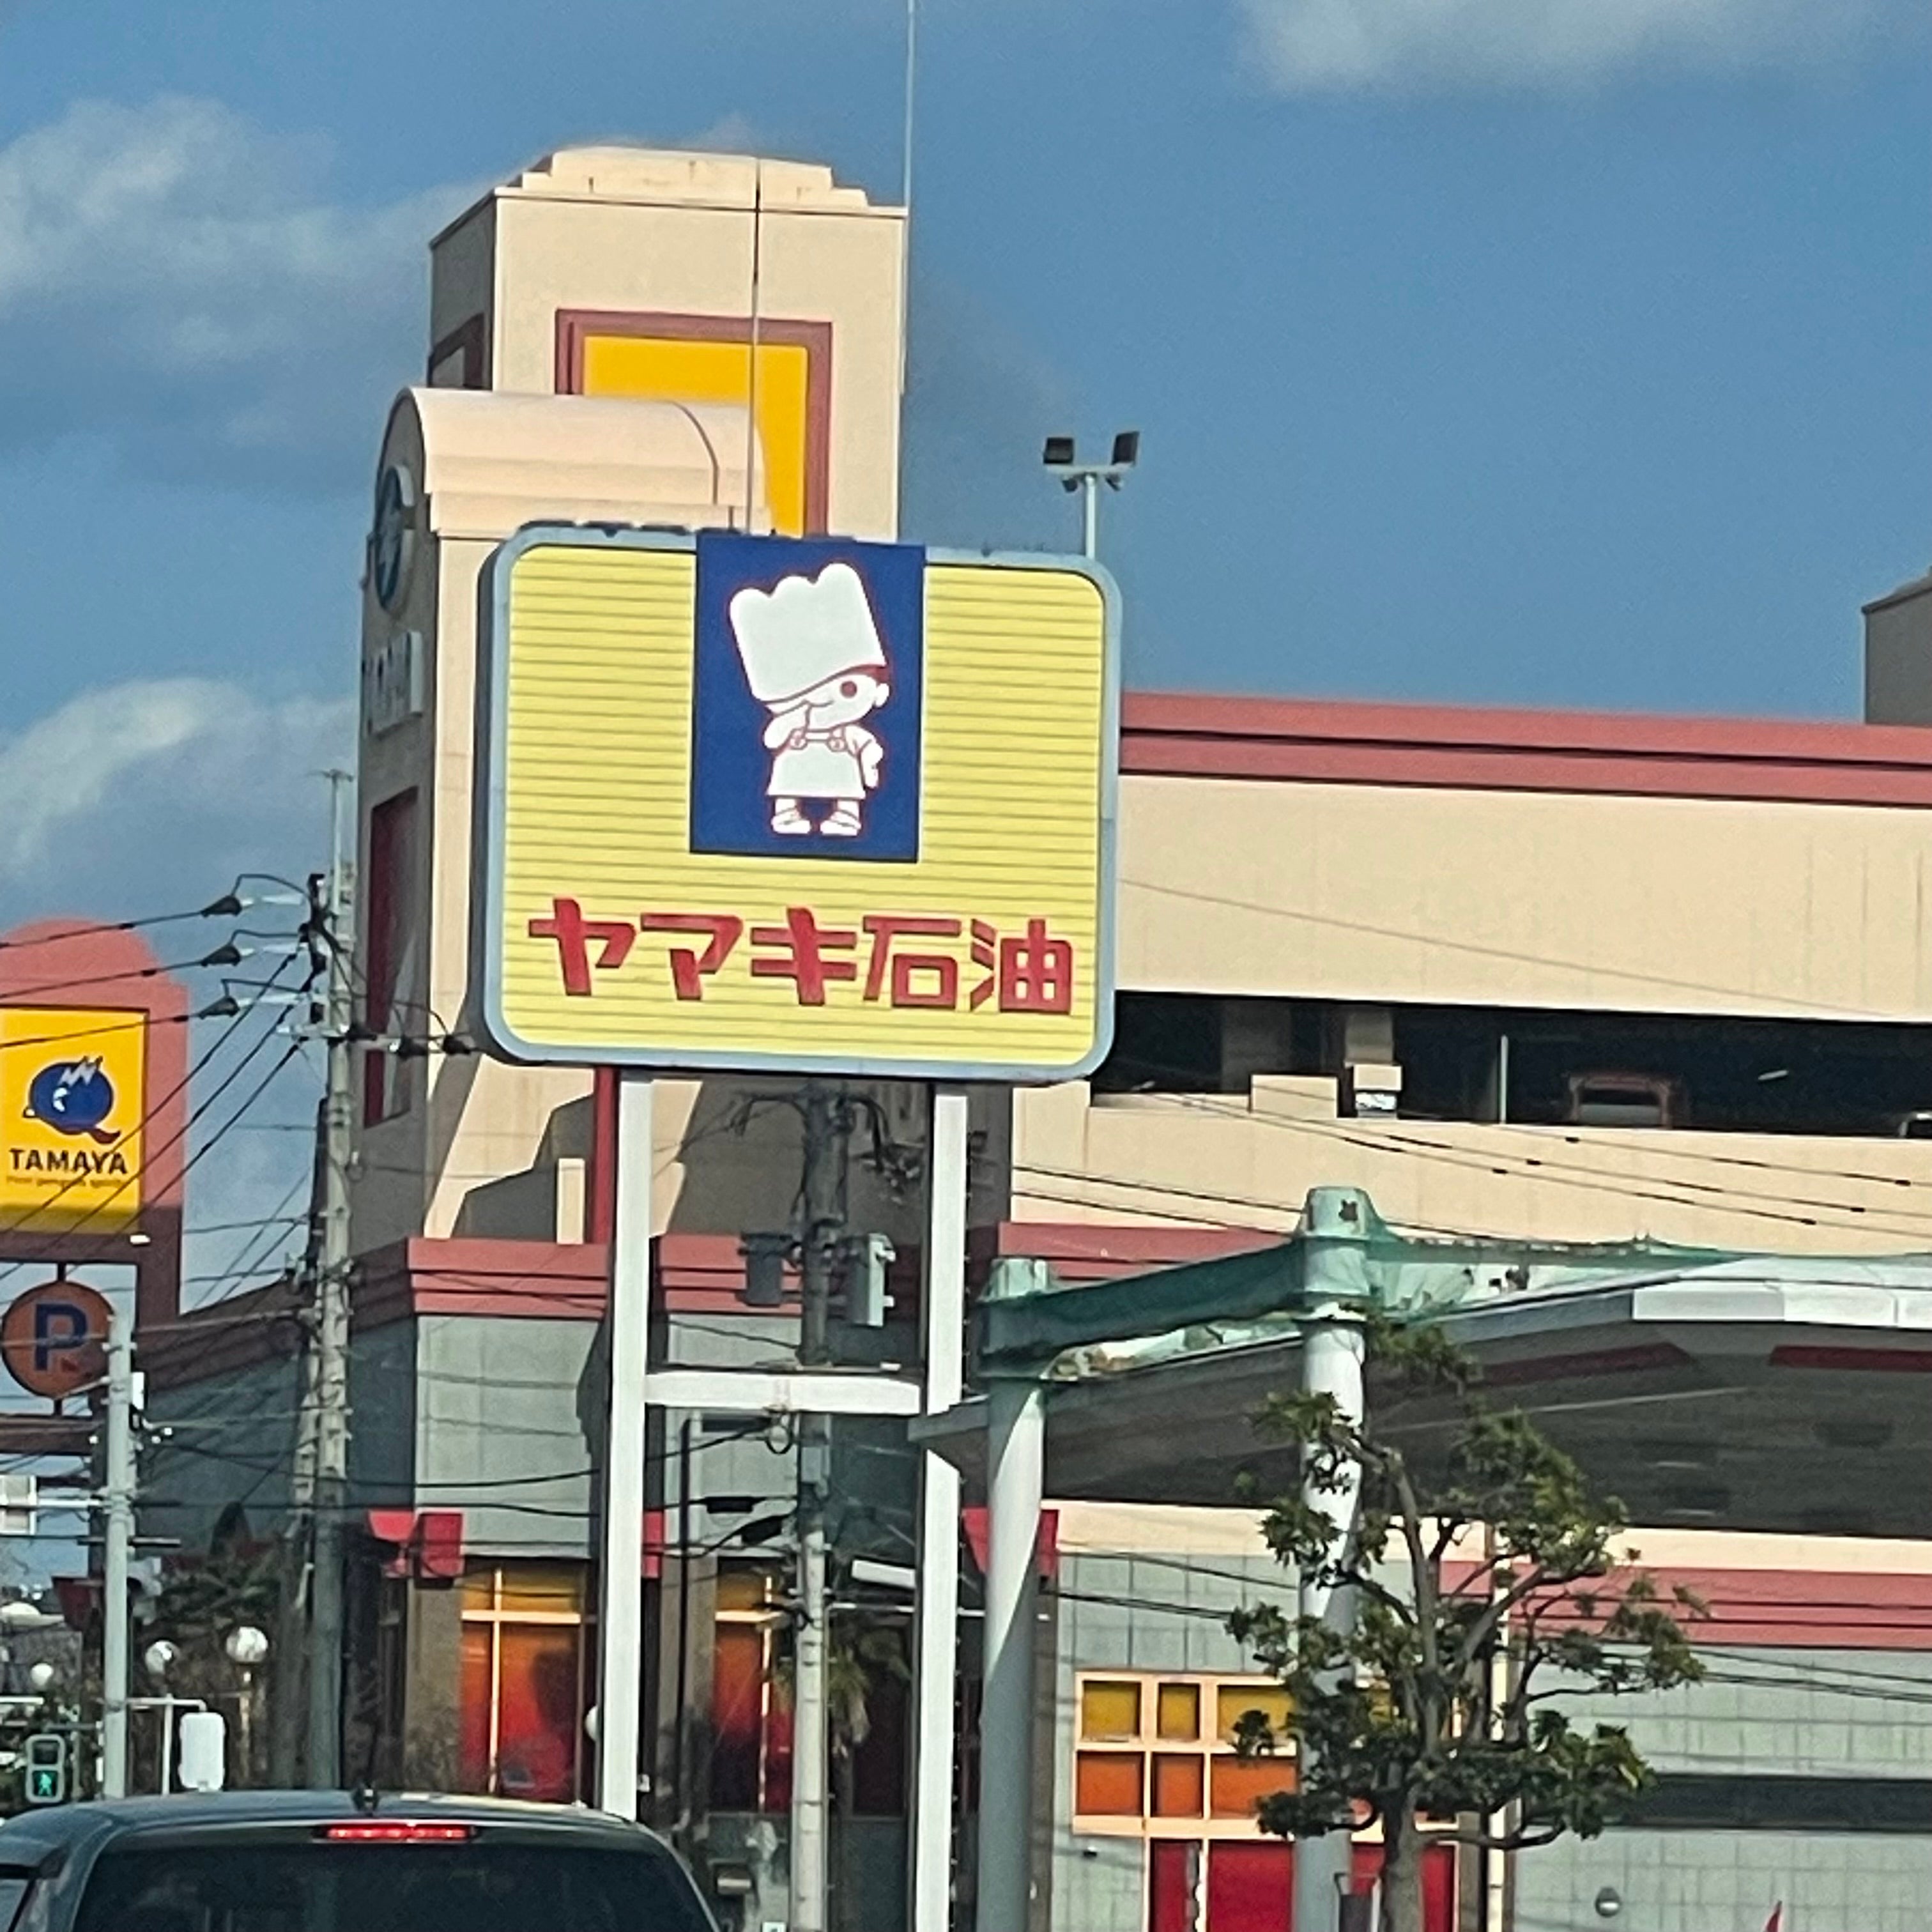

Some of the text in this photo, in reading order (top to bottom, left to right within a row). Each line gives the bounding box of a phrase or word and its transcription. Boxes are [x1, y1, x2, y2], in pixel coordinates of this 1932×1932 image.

[528, 898, 1073, 1014] ヤマキ石油
[9, 1148, 127, 1174] TAMAYA
[35, 1304, 88, 1370] P
